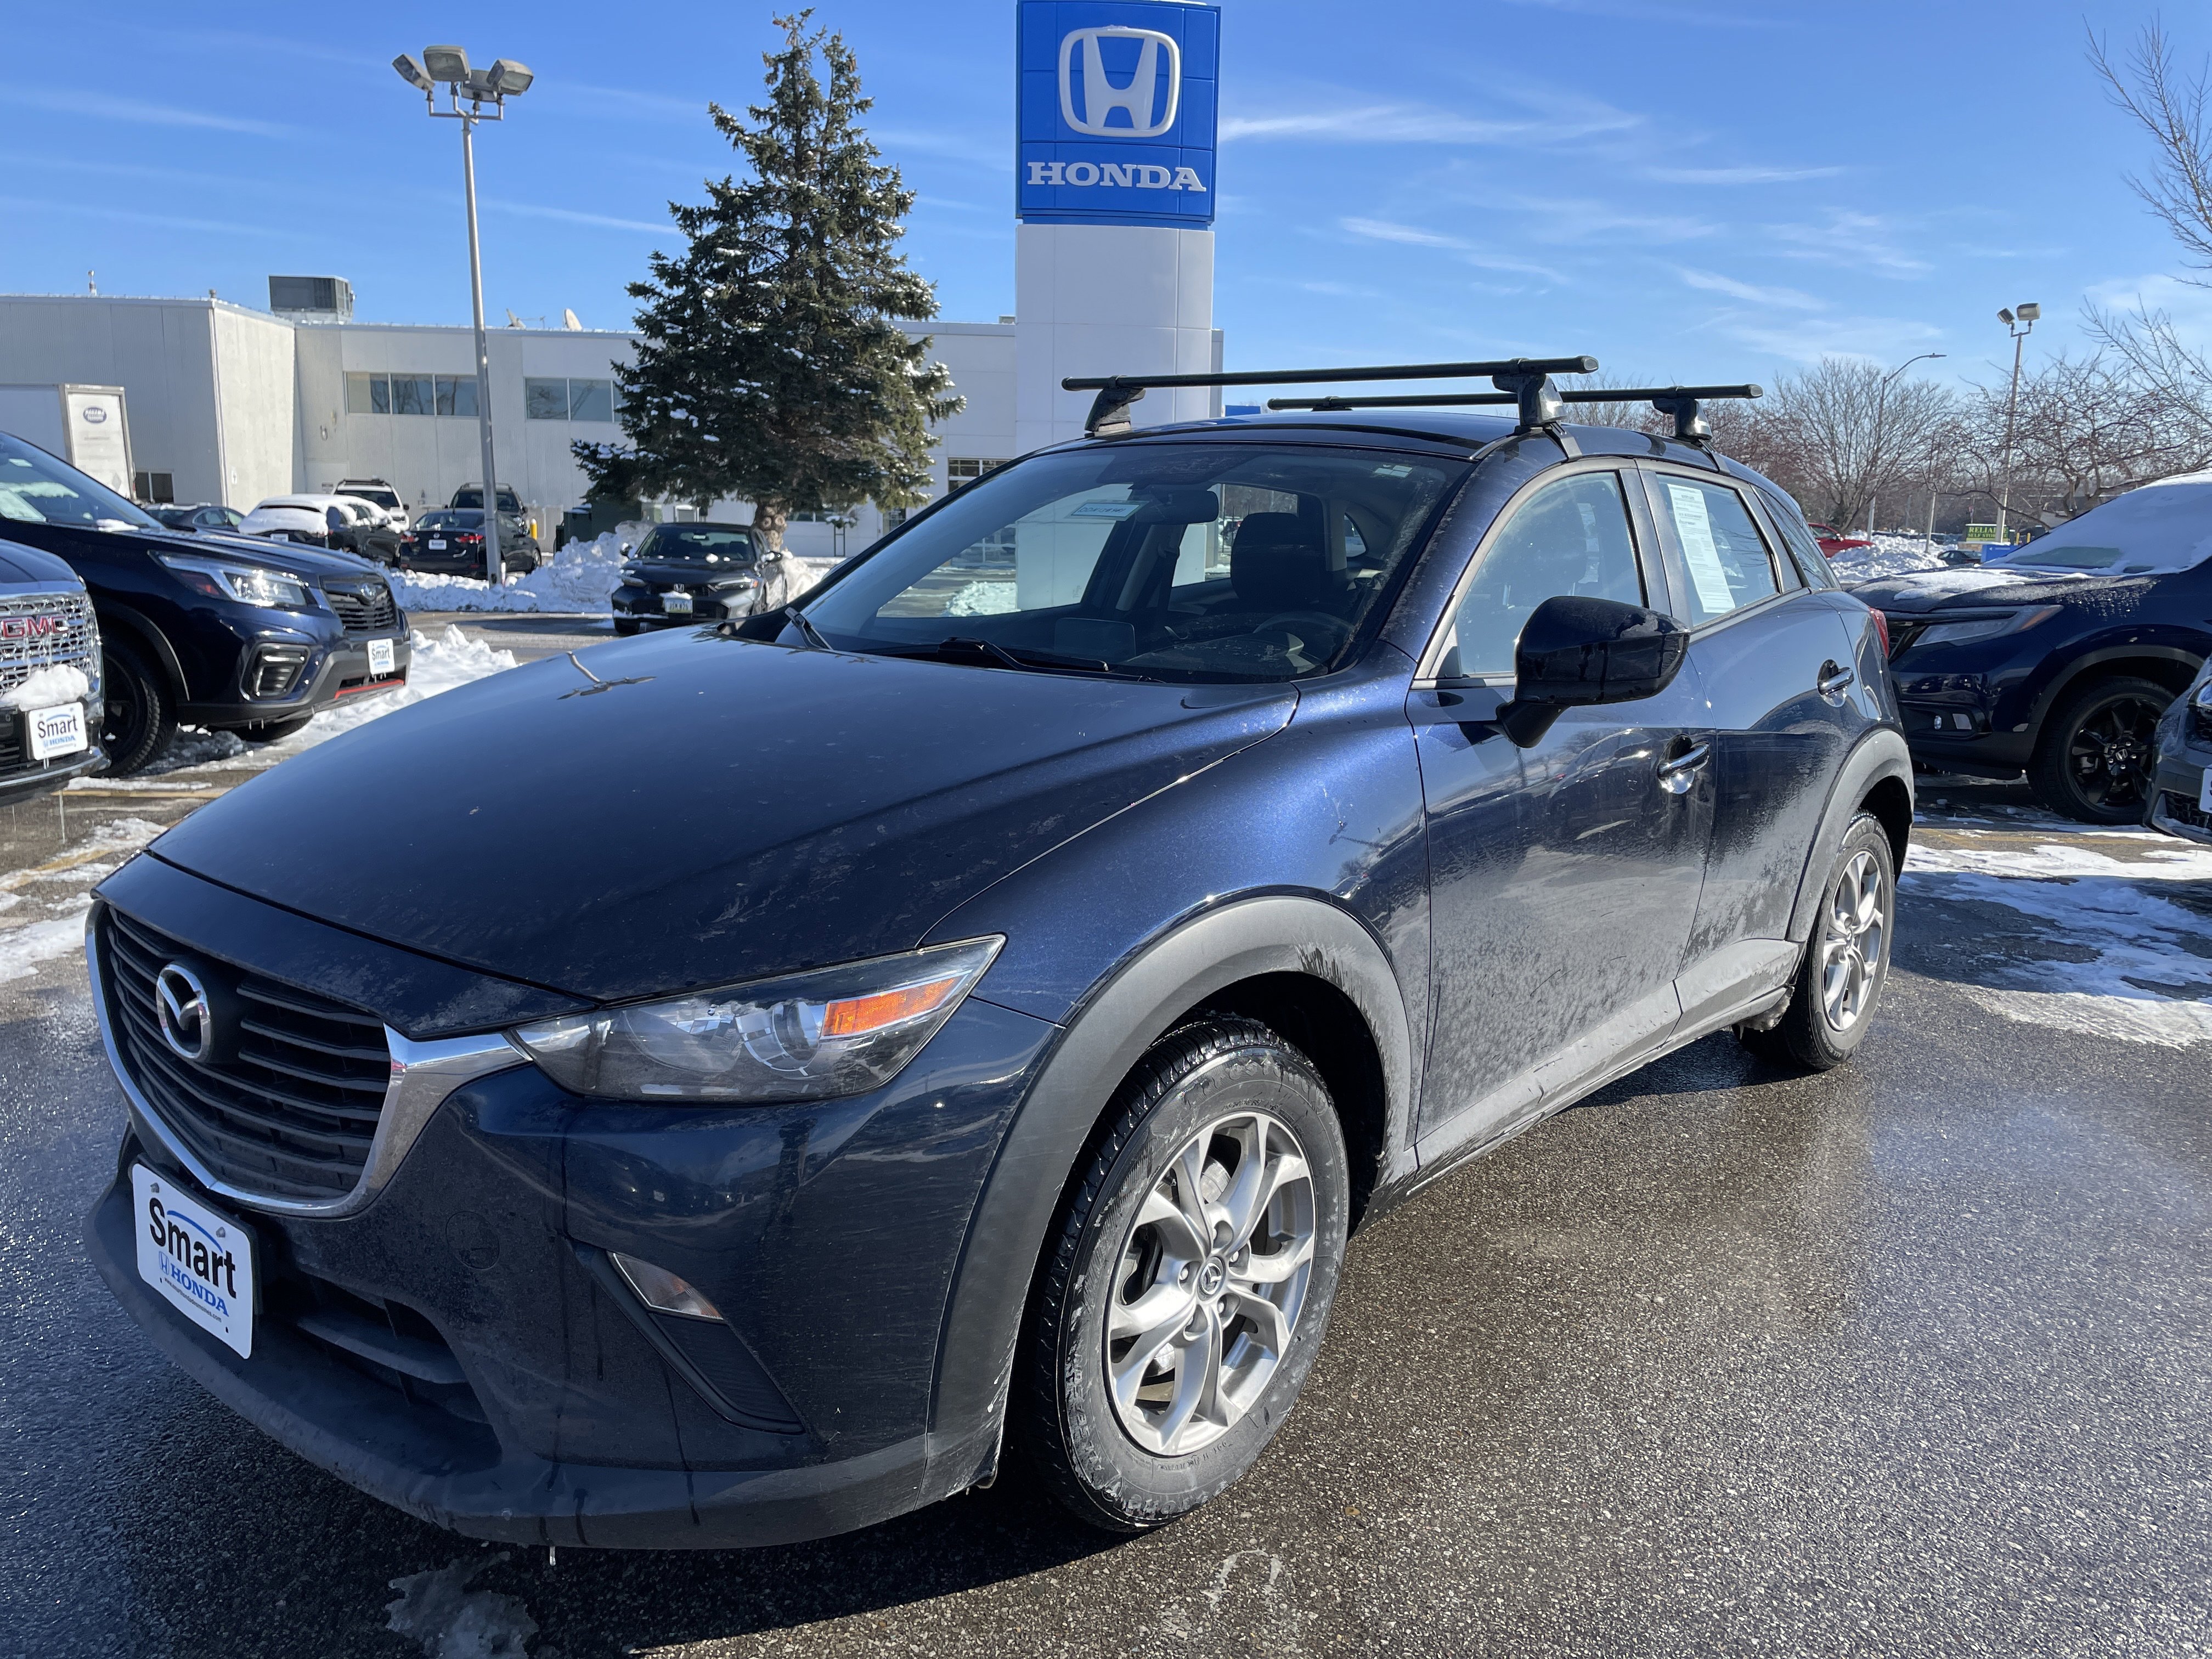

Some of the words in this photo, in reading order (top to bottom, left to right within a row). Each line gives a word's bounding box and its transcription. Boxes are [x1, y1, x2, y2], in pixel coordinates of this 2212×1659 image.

[1027, 162, 1207, 192] HONDA
[2, 616, 69, 638] GMC
[371, 646, 391, 662] Smart
[37, 715, 78, 738] Smart
[49, 735, 76, 746] HONDA
[149, 1197, 237, 1299] Smart
[171, 1263, 229, 1317] HONDA
